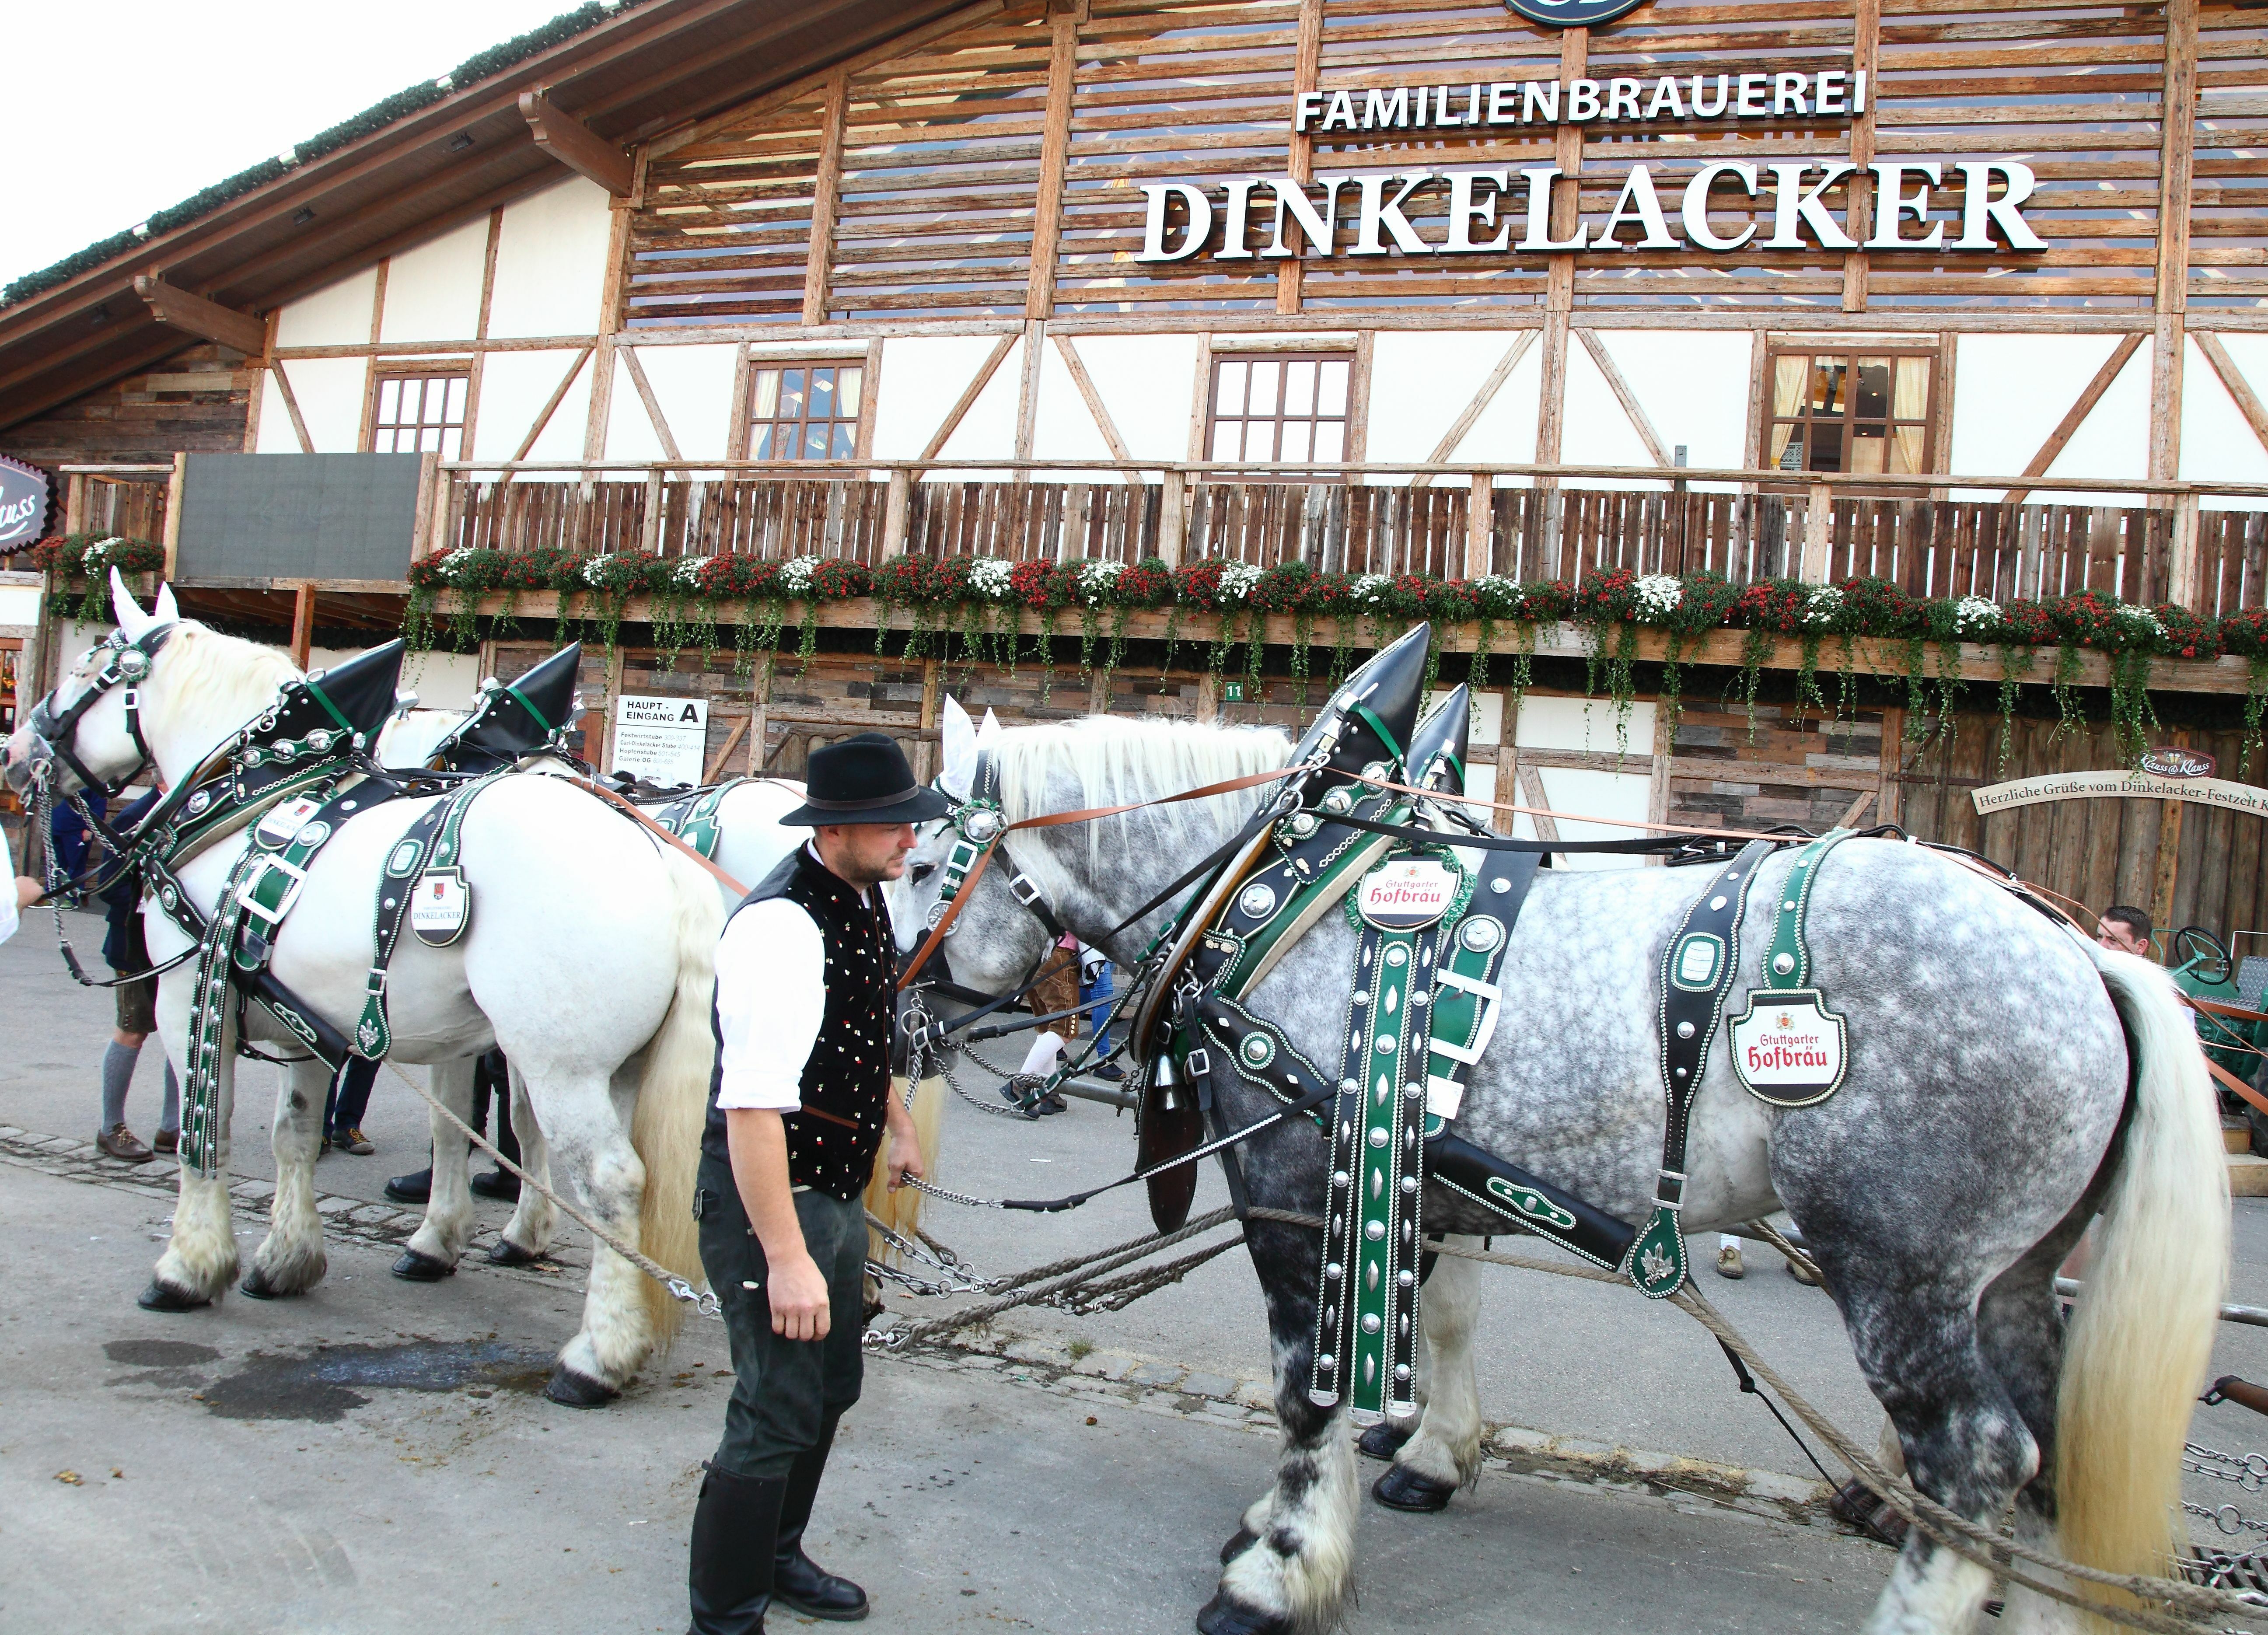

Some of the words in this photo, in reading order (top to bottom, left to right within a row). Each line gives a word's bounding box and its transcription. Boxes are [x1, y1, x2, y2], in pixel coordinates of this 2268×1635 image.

[1296, 70, 1866, 133] FAMILIENBRAUEREI
[1134, 161, 2049, 263] DINKELACKER
[1227, 686, 1241, 697] 11
[627, 701, 663, 710] HAUPT
[626, 711, 674, 722] EINGANG
[679, 704, 699, 723] A
[621, 732, 662, 740] Festwirtstube
[620, 740, 660, 748] Carl-Dinkelacker
[619, 748, 657, 756] Hopfenstube
[2179, 759, 2209, 776] Klauss
[1978, 786, 2041, 807] Herzliche
[2043, 781, 2085, 795] Grüße
[2088, 783, 2118, 792] vom
[2121, 780, 2257, 808] Dinkelacker-Festzelt
[1386, 880, 1438, 889] Stuttgarter
[1370, 887, 1441, 905] Hofbräu
[413, 911, 461, 919] DINKELACKER
[1760, 1034, 1819, 1048] Stuttgarter
[1748, 1046, 1828, 1073] Hofbräu
